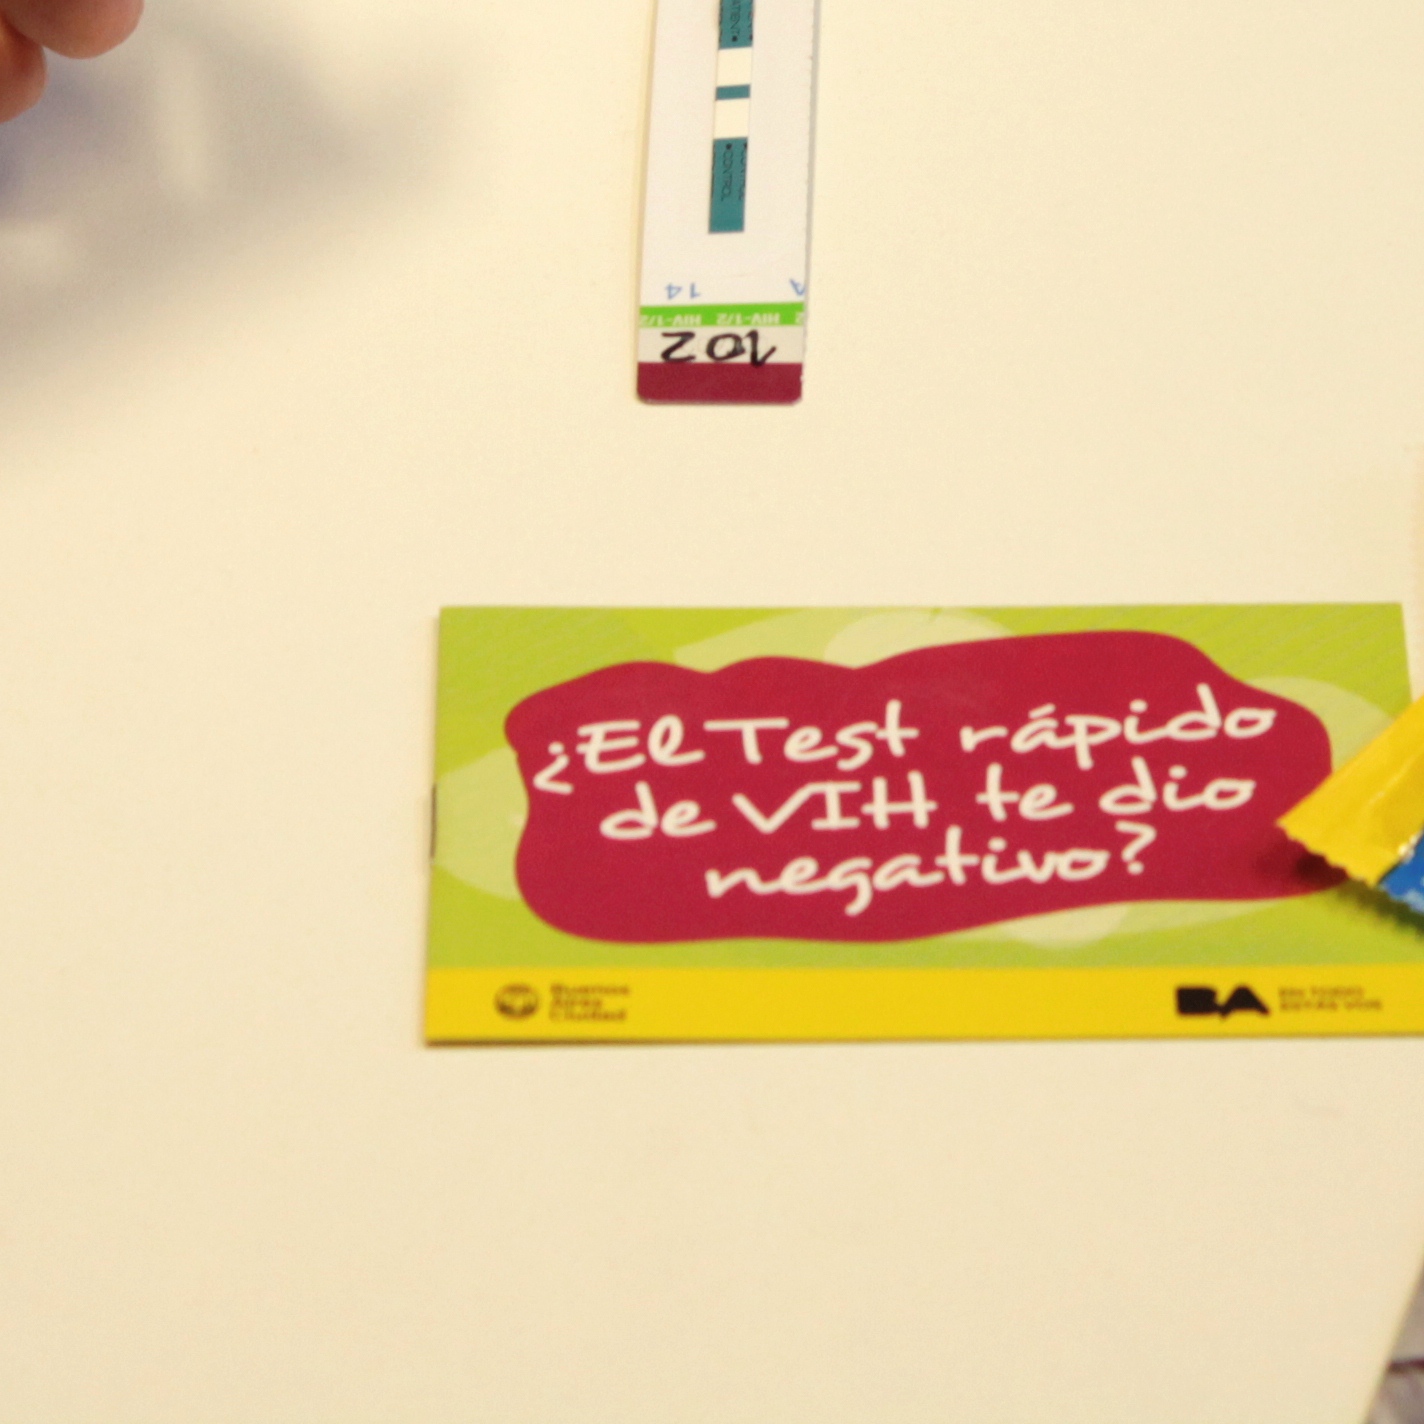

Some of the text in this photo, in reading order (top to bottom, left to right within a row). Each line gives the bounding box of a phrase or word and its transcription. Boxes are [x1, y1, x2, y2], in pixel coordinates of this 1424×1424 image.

[661, 330, 776, 368] 102
[532, 682, 1278, 794] ¿El Test rápido
[598, 755, 1257, 840] de VIH te dio
[704, 821, 1157, 915] negativo?
